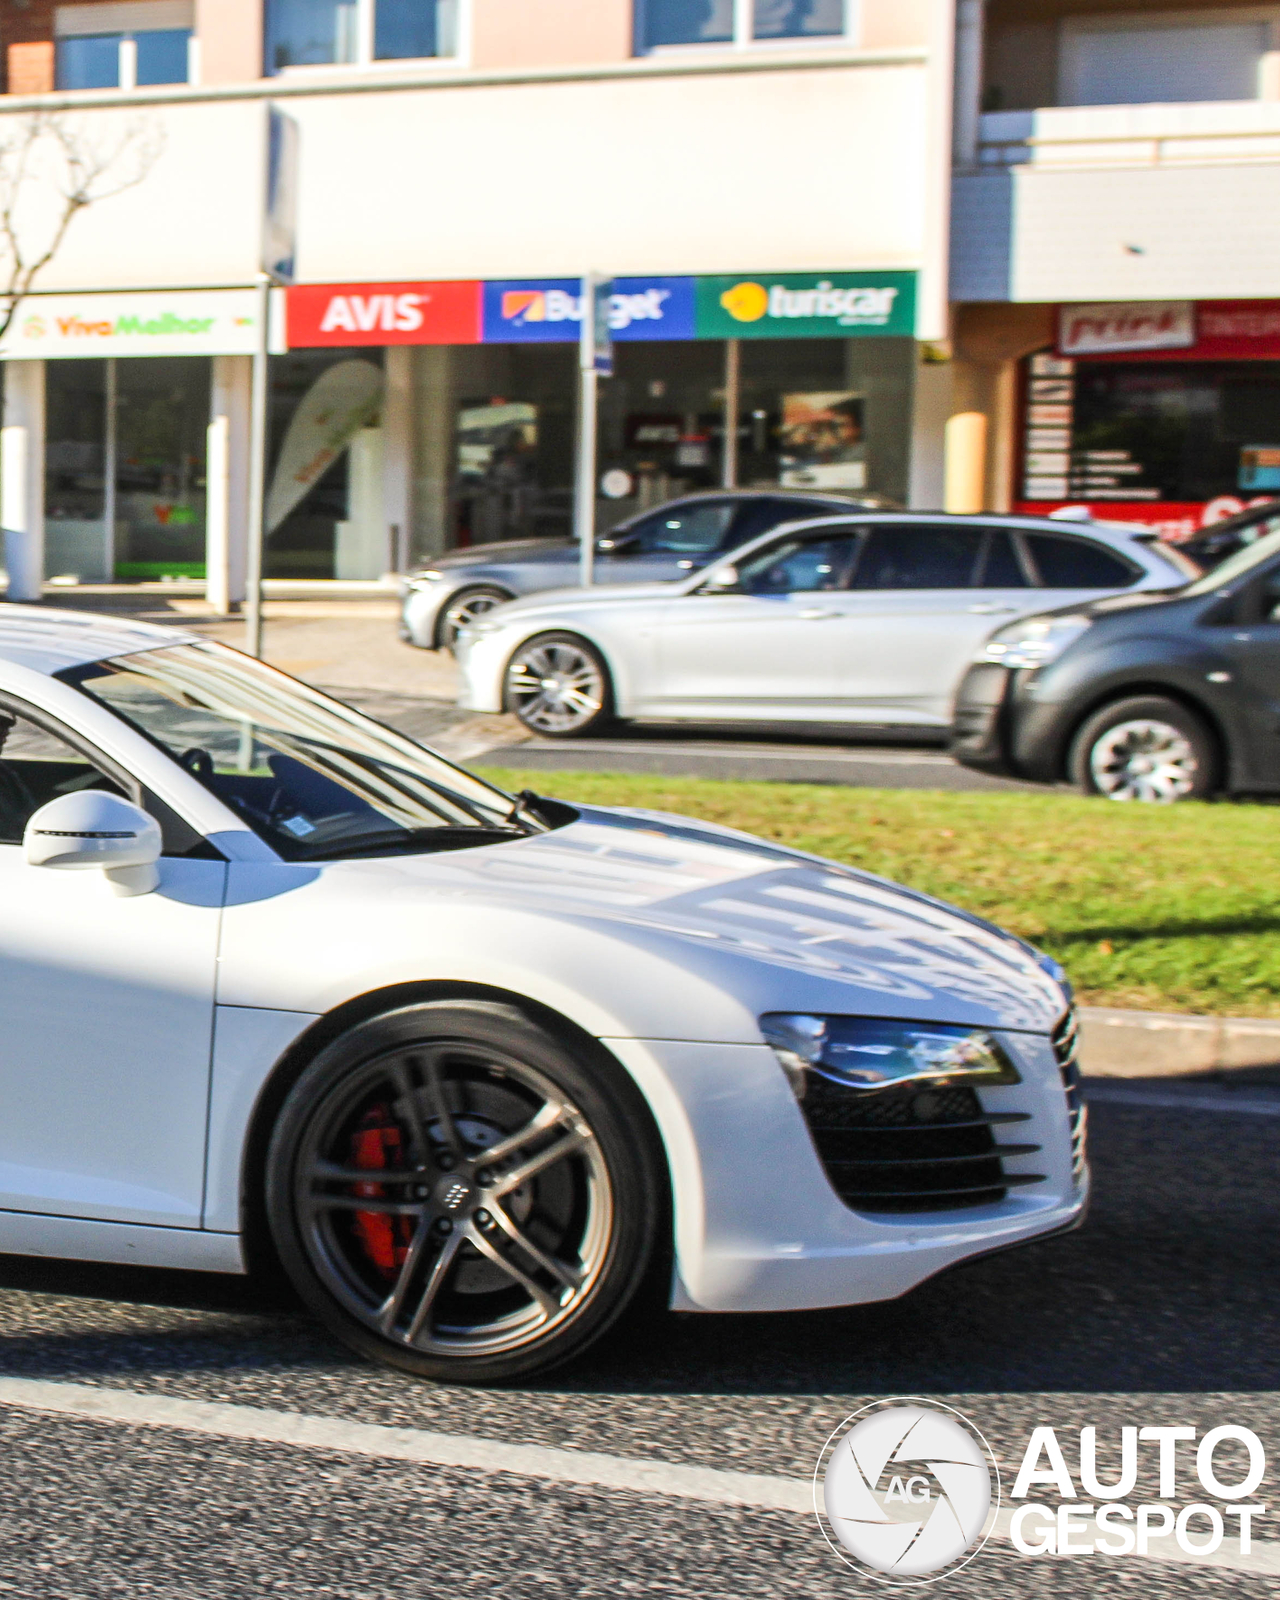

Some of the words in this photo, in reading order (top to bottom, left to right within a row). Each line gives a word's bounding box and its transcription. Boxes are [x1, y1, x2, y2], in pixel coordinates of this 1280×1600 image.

[320, 292, 424, 332] AVIS
[545, 288, 664, 330] Buget
[769, 280, 898, 318] turiscar
